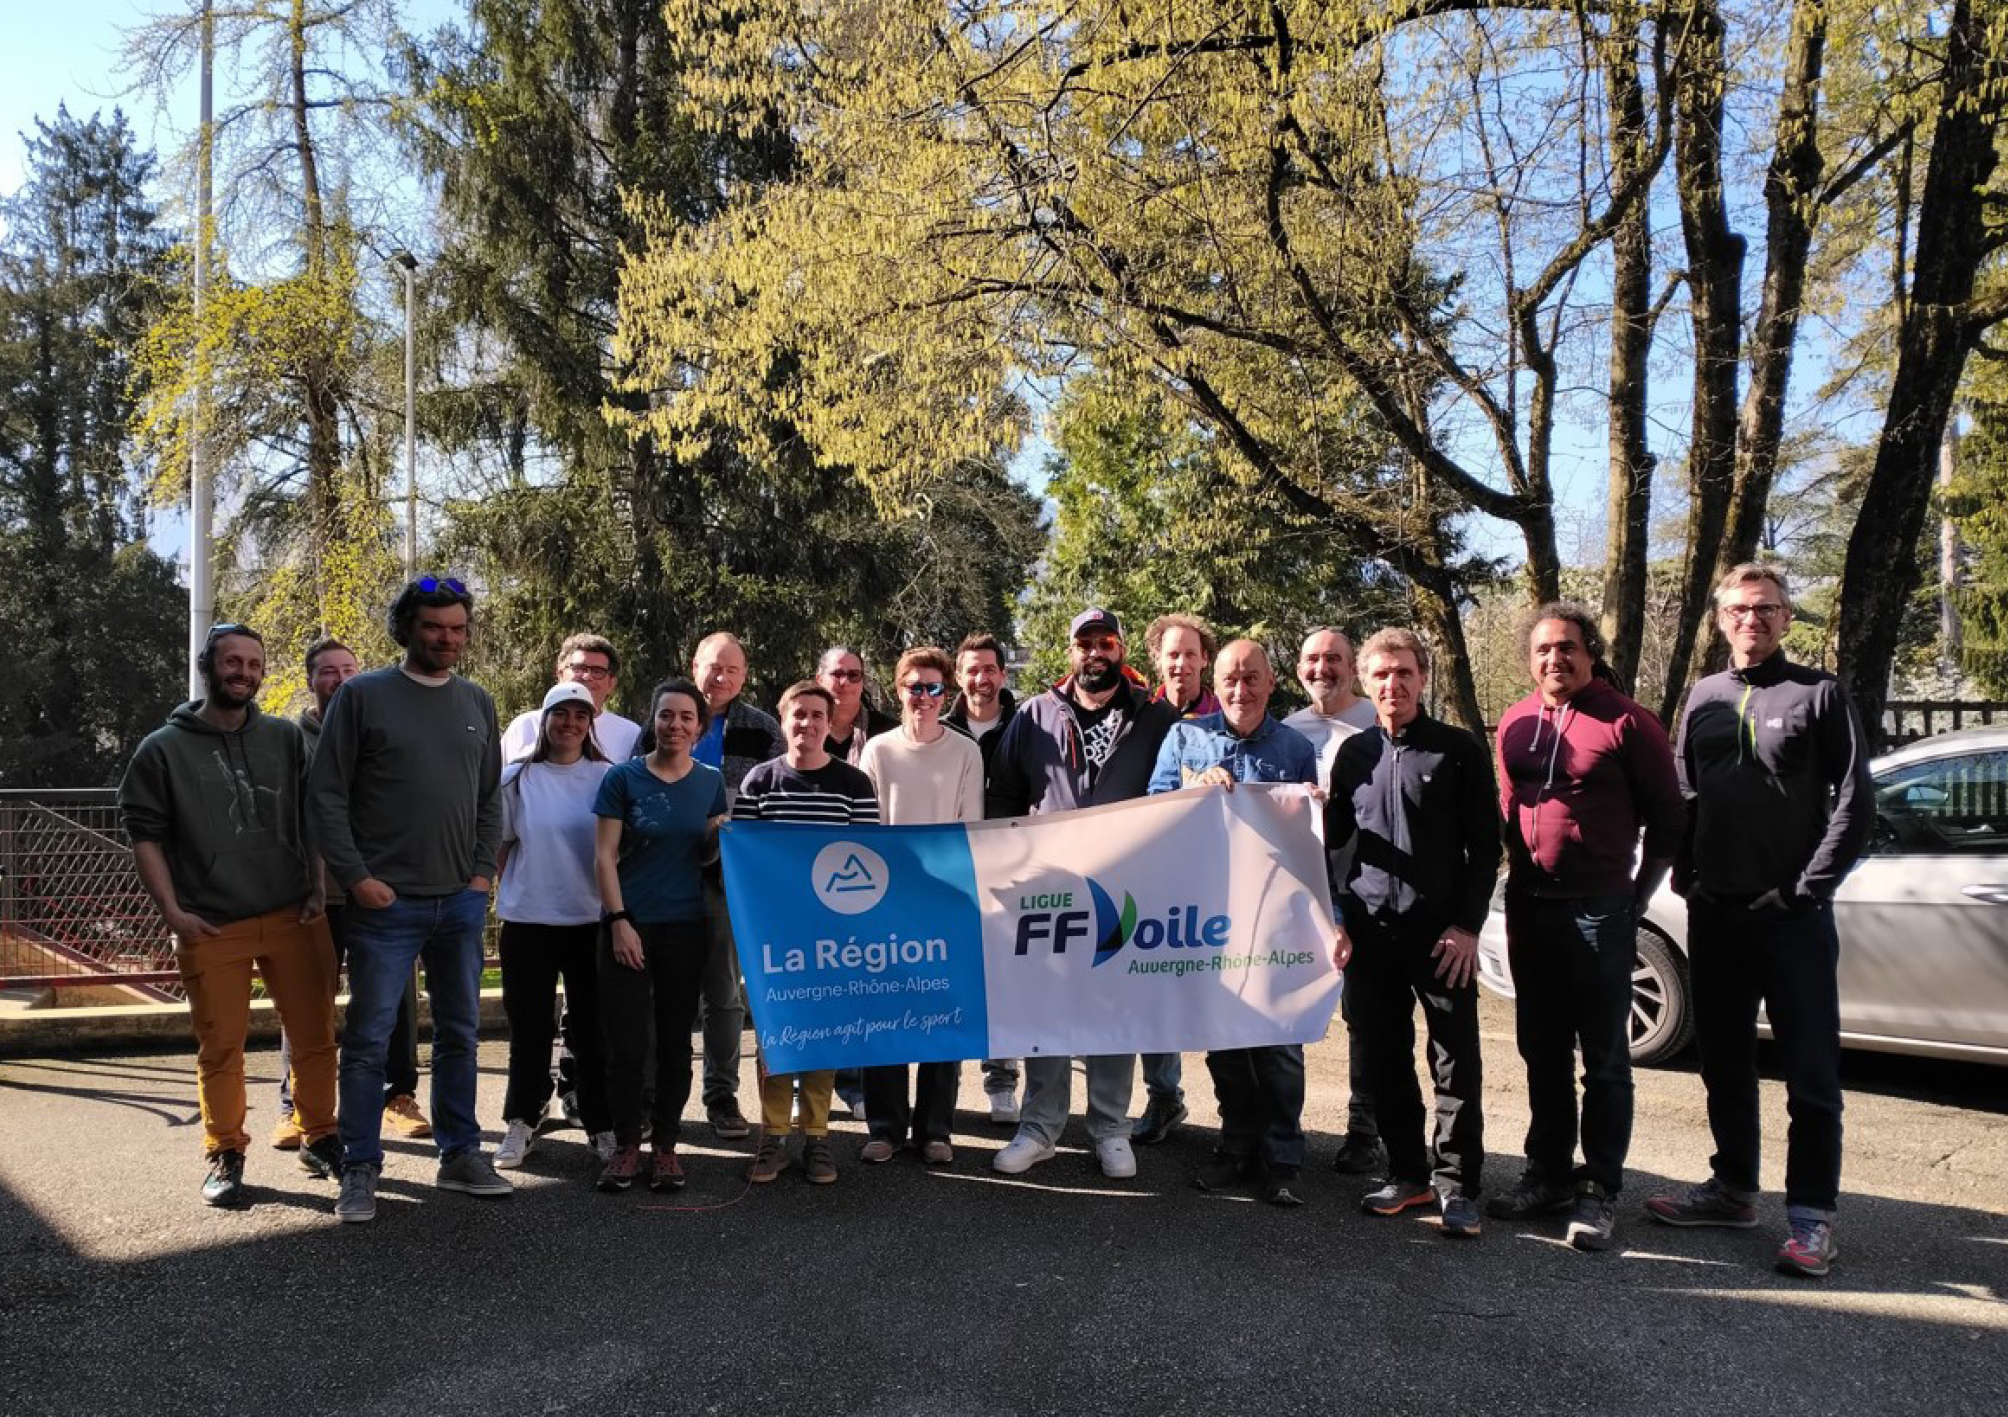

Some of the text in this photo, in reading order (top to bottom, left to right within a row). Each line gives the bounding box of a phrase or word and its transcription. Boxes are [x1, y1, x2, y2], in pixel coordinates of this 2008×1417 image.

[1019, 892, 1073, 910] LIGUE
[761, 933, 948, 975] La Région
[1128, 949, 1315, 977] Auvergne-Rhône-Alpes
[765, 976, 950, 1003] Auvergne-Rhône-Alpes
[779, 1025, 832, 1051] Région
[832, 1018, 865, 1046] agit
[864, 1017, 900, 1042] pour
[903, 1009, 919, 1030] le
[920, 1006, 963, 1035] sport
